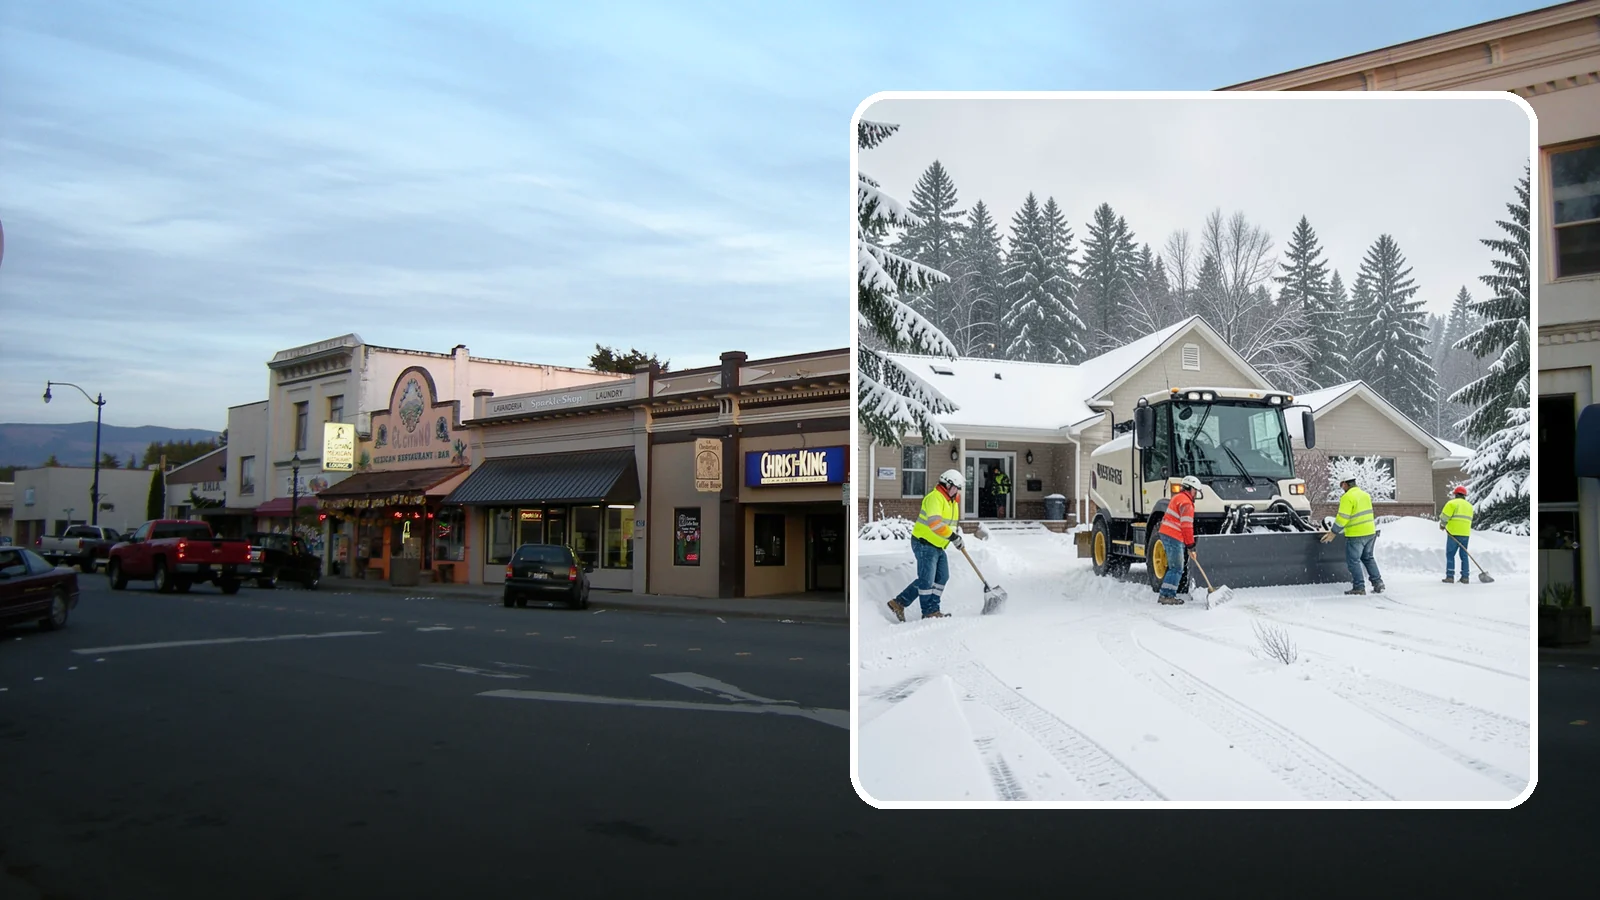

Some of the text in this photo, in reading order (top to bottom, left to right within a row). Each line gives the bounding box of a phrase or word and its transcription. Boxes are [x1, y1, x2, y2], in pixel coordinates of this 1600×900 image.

[531, 394, 583, 408] Sparkle Shop
[595, 388, 624, 400] LAUNDRY
[493, 402, 523, 412] LAVANDERIA
[374, 454, 396, 464] MEXICAN
[397, 451, 433, 462] RESTAURANT
[438, 450, 450, 459] BAR
[761, 450, 827, 478] CHRIST KING
